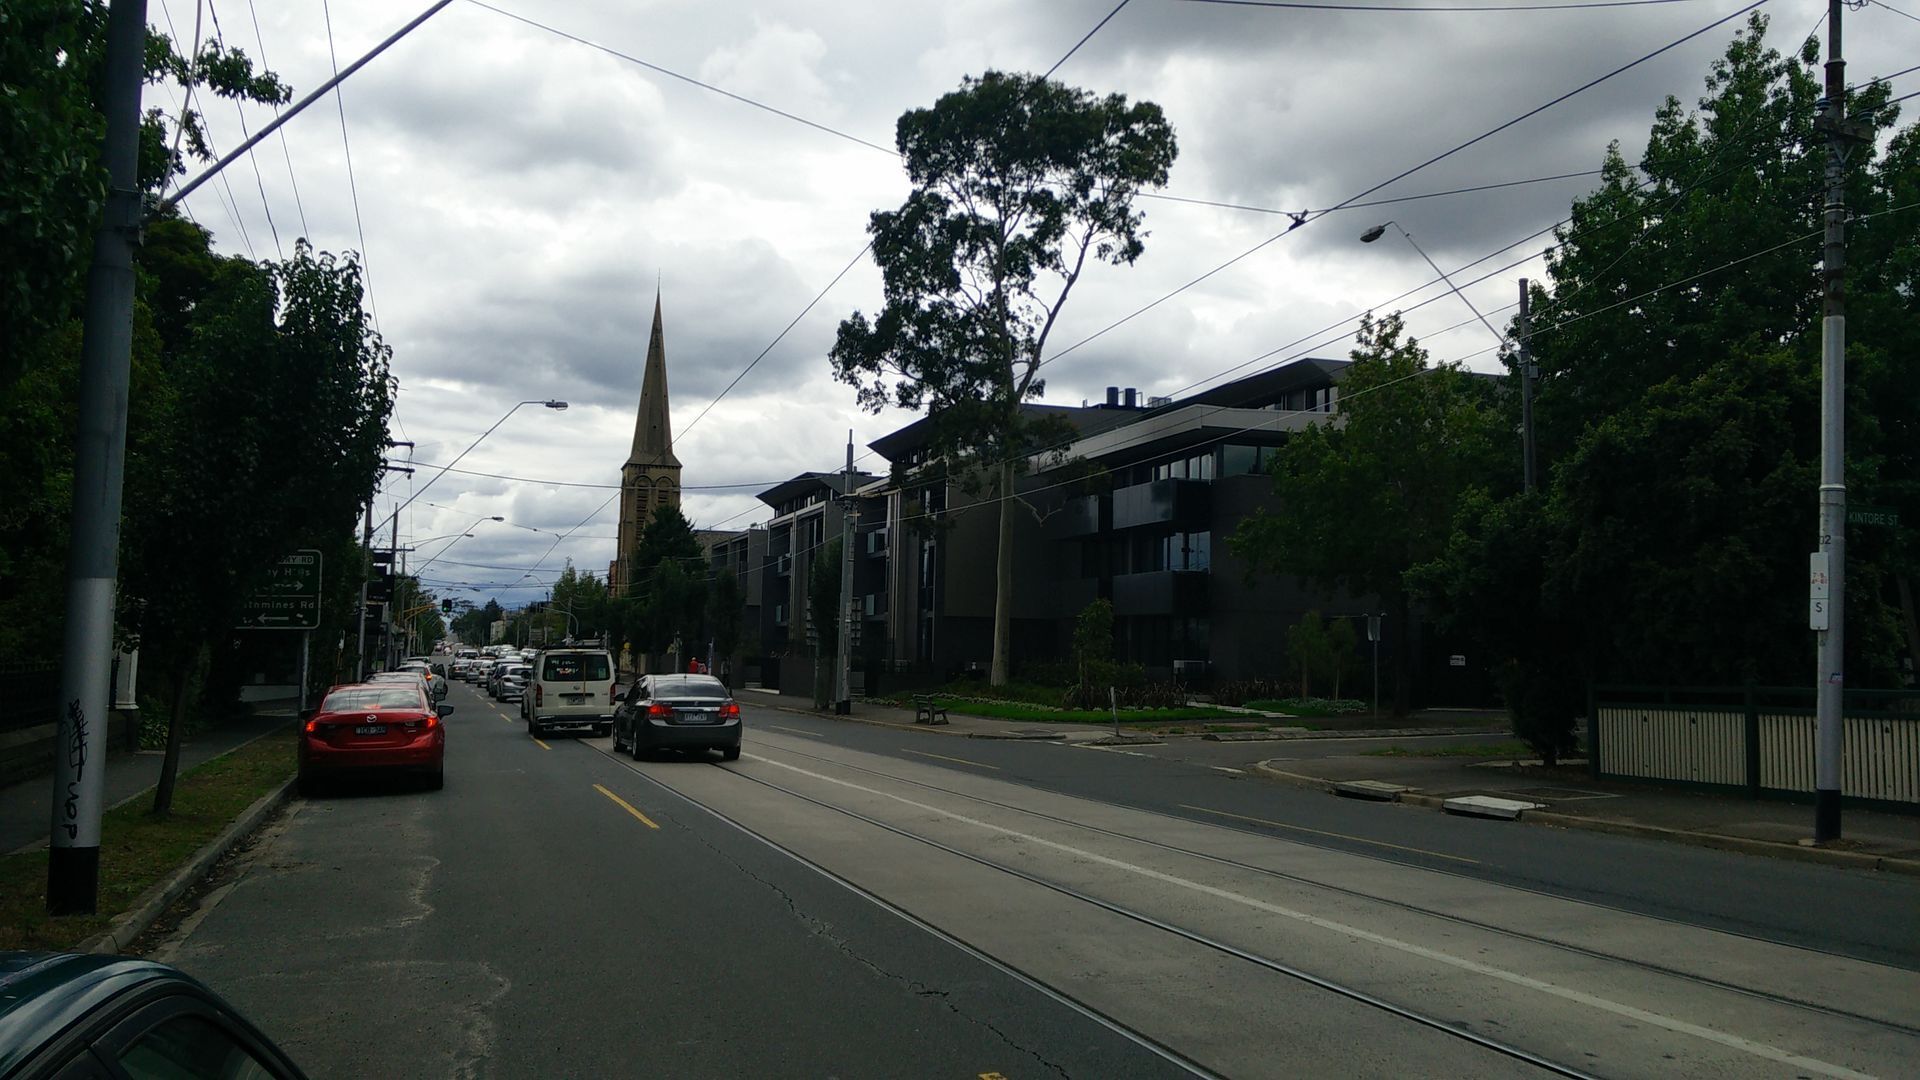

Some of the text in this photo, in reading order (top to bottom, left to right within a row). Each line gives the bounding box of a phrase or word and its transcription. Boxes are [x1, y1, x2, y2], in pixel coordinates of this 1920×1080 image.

[1848, 512, 1899, 526] KINTORE ST
[300, 600, 315, 609] Rd
